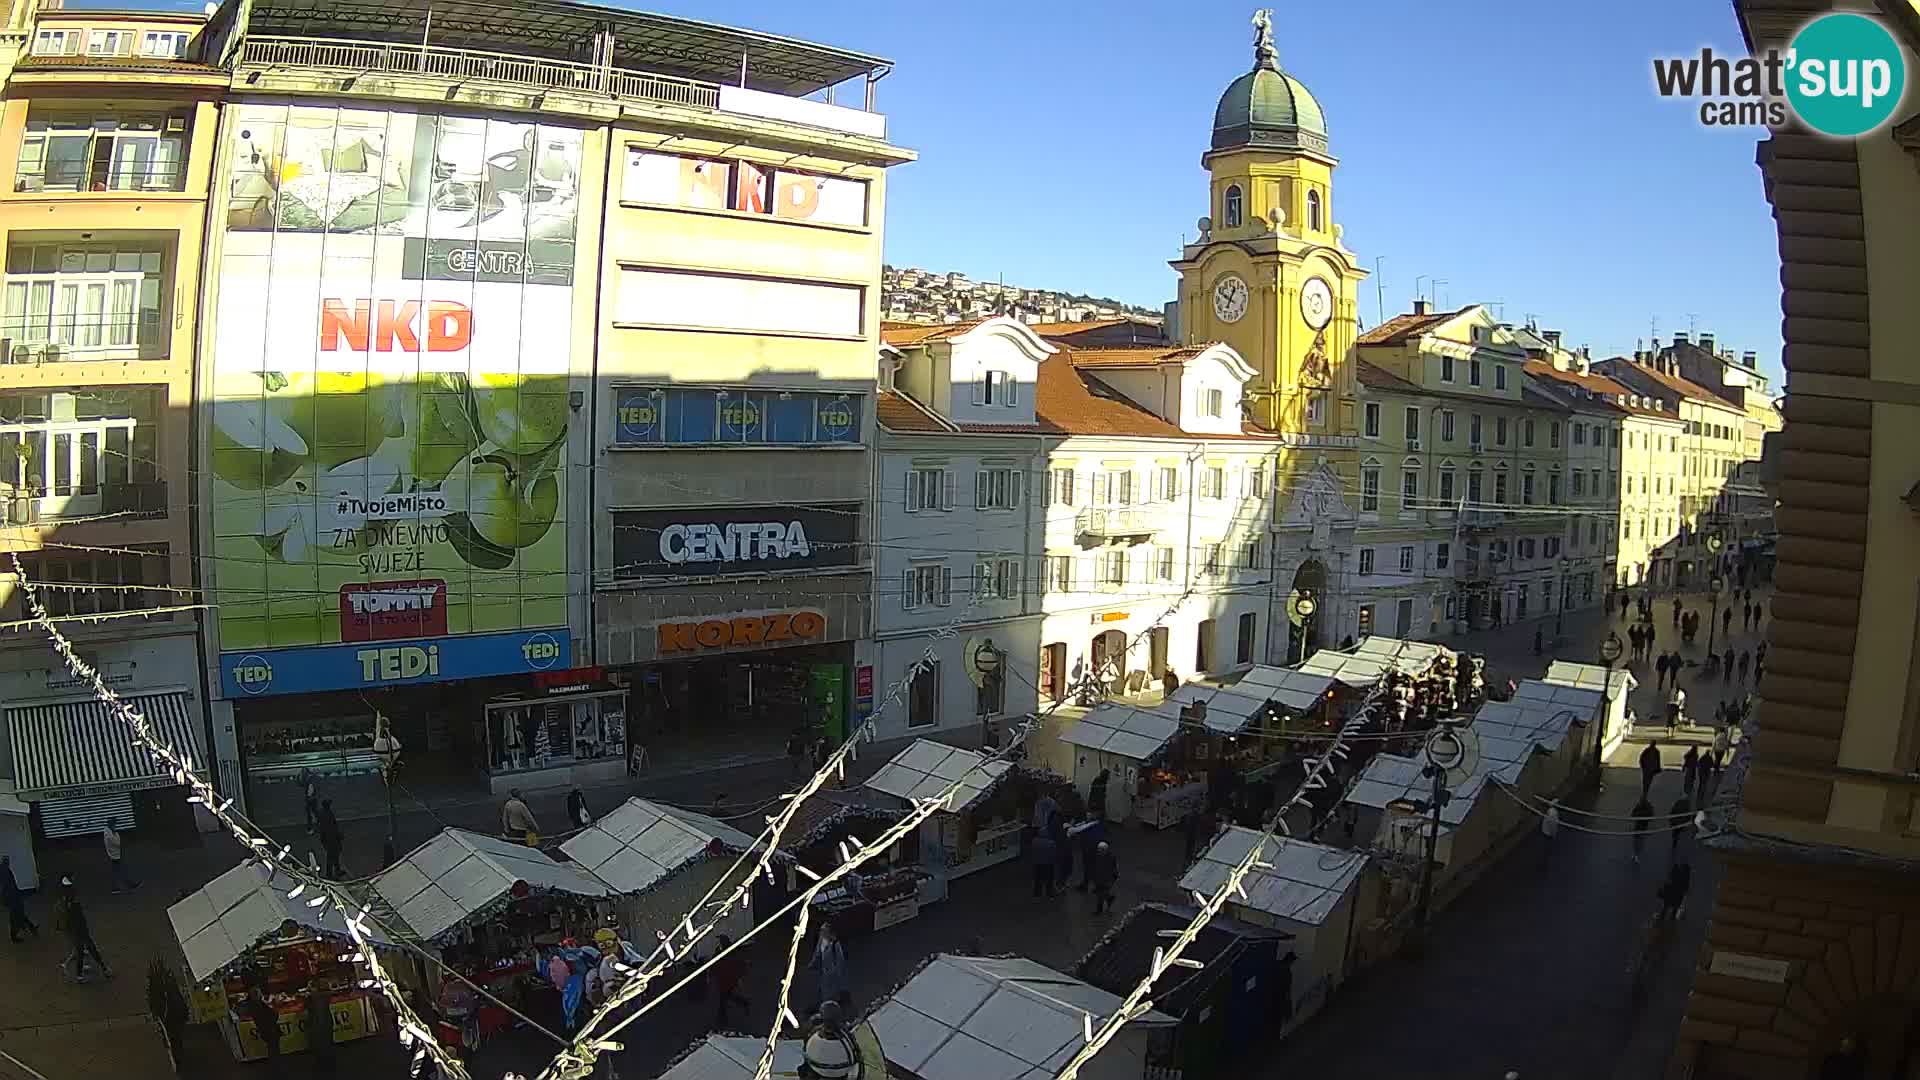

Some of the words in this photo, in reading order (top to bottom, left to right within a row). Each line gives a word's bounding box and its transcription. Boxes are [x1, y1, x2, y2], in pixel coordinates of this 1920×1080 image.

[448, 249, 535, 275] CENTRA
[320, 298, 475, 352] NKD
[337, 495, 446, 516] #TvojeMisto
[333, 528, 357, 548] ZA
[366, 523, 450, 547] DNEVNO
[659, 520, 810, 563] CENTRA
[359, 547, 425, 574] SVJEŽE
[657, 610, 826, 655] KORZO
[357, 645, 440, 681] TEDi
[522, 642, 560, 660] TEDi
[233, 666, 273, 683] TEDi
